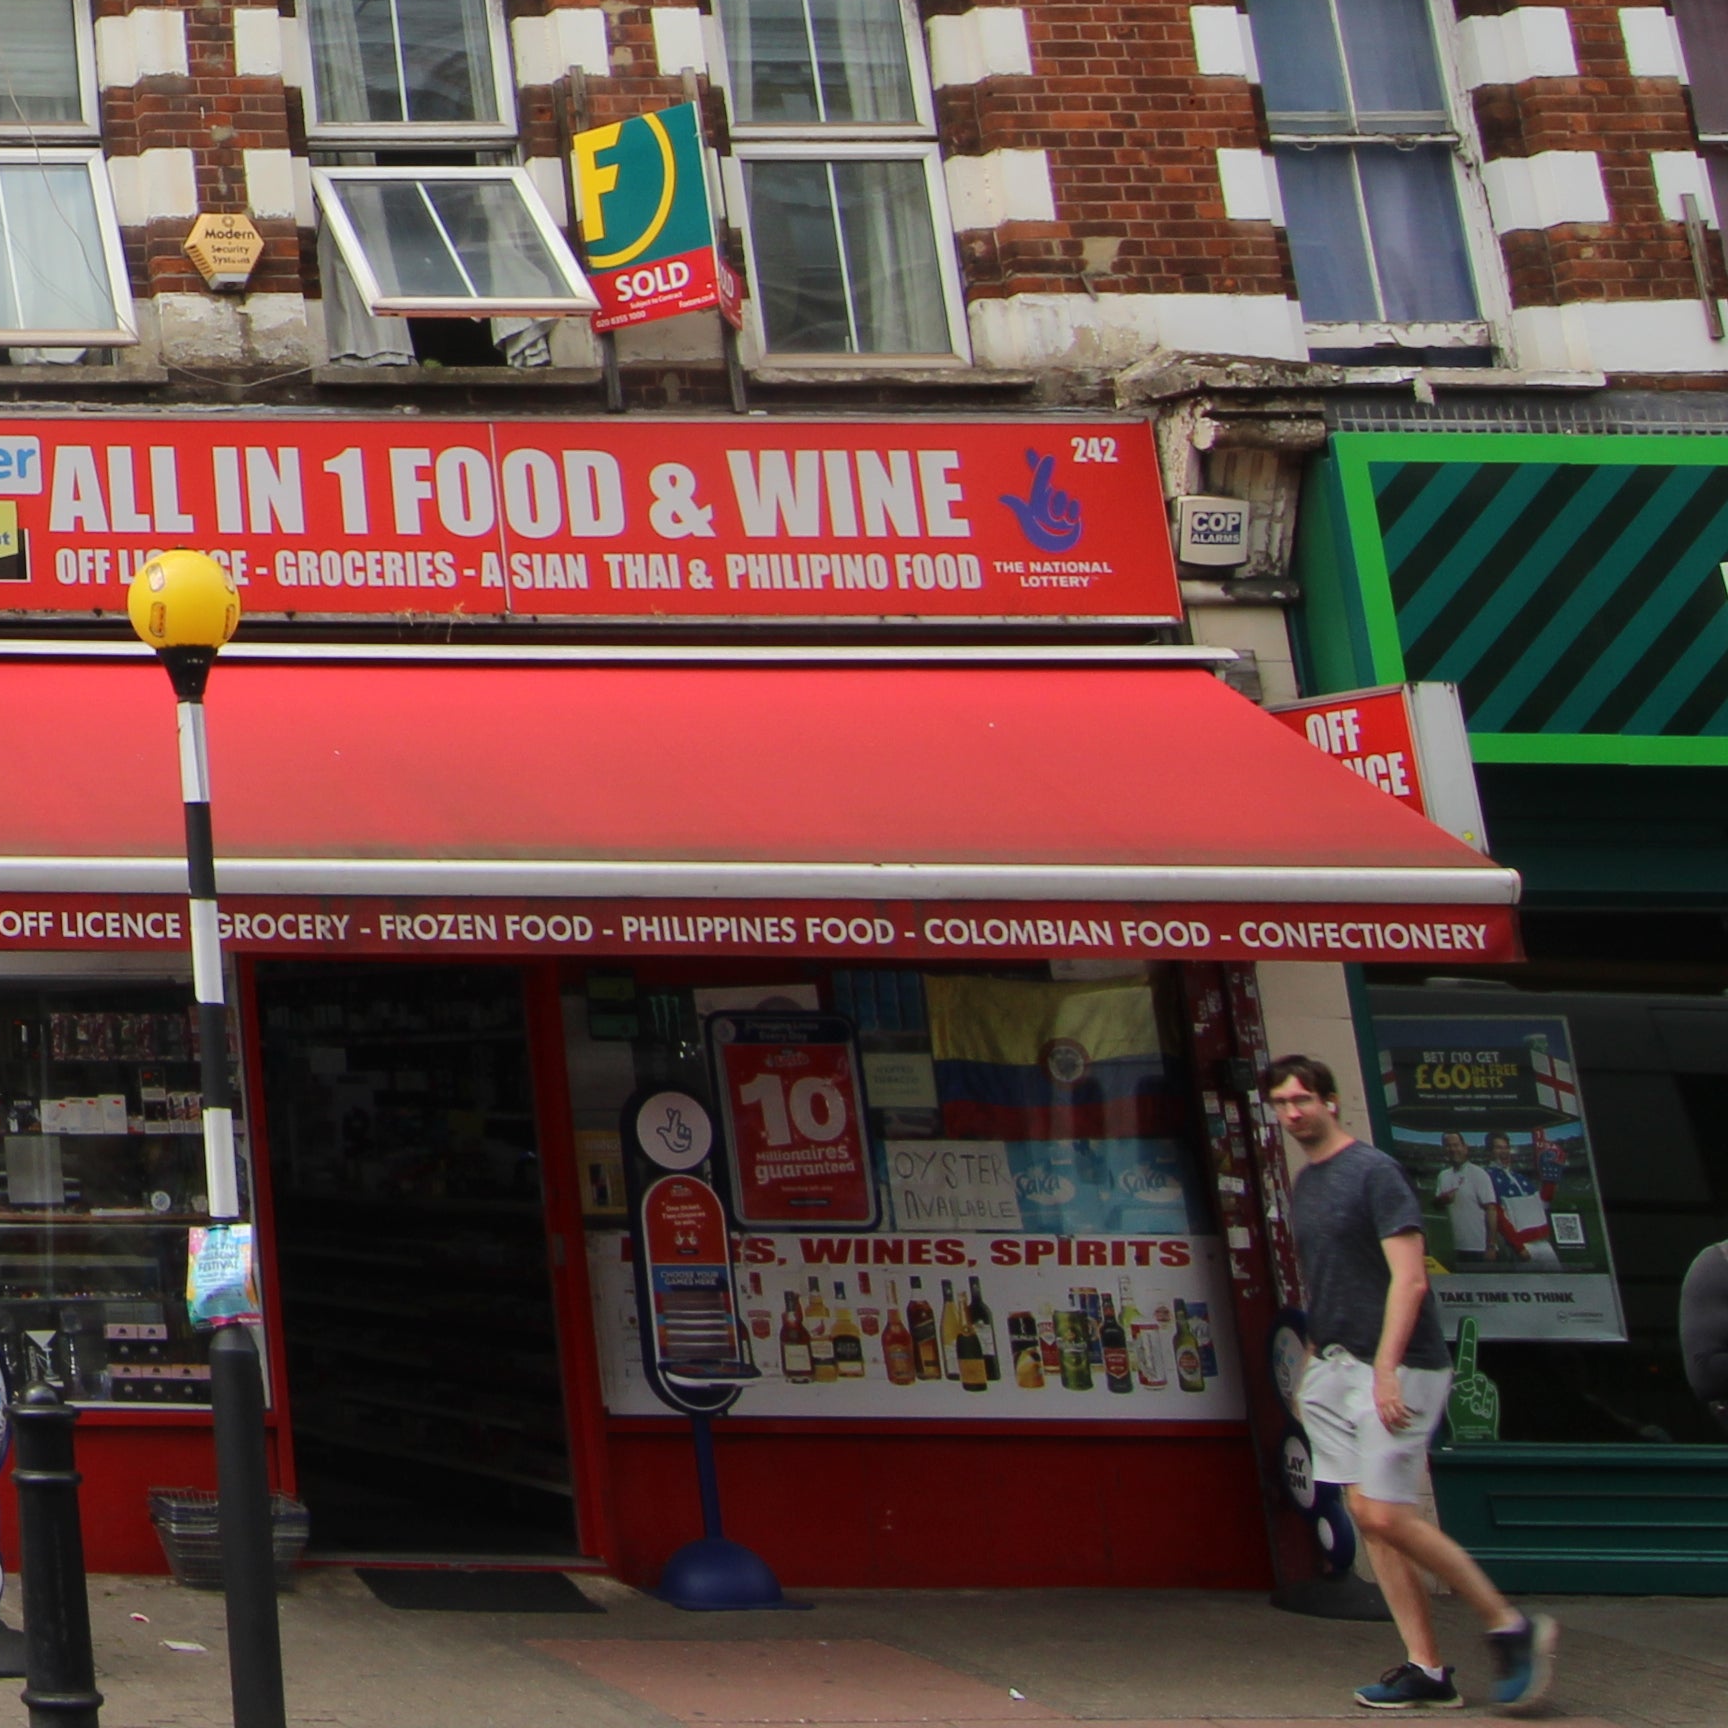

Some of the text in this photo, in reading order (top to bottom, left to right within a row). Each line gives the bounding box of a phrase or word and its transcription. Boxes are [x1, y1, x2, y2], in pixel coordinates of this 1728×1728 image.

[205, 229, 255, 240] Modern
[211, 245, 250, 255] Security
[615, 261, 690, 302] SOLD
[1071, 437, 1119, 464] 242
[49, 445, 971, 539] ALL IN 1 FOOD & WINE
[1192, 511, 1241, 533] COP
[1192, 532, 1241, 545] ALARMS
[55, 548, 111, 585] OFF
[275, 550, 455, 588] GROCERIES
[604, 553, 680, 590] THAI
[689, 559, 713, 590] &
[727, 553, 891, 590] PHILIPINO
[896, 553, 982, 590] FOOD
[994, 561, 1113, 574] THE NATIONAL
[1020, 575, 1091, 588] LOTTERY
[1305, 708, 1361, 754] OFF
[61, 912, 181, 940] LICENCE
[218, 913, 350, 941] GROCERY
[380, 914, 497, 941] FROZEN
[505, 915, 594, 942] FOOD
[623, 915, 797, 944] PHILIPPINES
[805, 917, 895, 945] FOOD
[924, 918, 1114, 947] COLOMBIAN
[1122, 920, 1211, 948] FOOD
[1239, 921, 1487, 951] CONFECTIONERY
[1423, 1051, 1444, 1063] BET
[1476, 1051, 1500, 1063] GET
[1415, 1063, 1472, 1090] £60
[739, 1072, 847, 1146] 10
[755, 1144, 849, 1162] Millionaires
[754, 1160, 856, 1185] guaranteed
[895, 1151, 1010, 1189] OYSTER
[904, 1190, 1017, 1220] AVAILABLE
[800, 1239, 978, 1268] WINES,
[990, 1238, 1192, 1267] SPIRITS
[1438, 1292, 1575, 1303] TAKE TIME TO THINK
